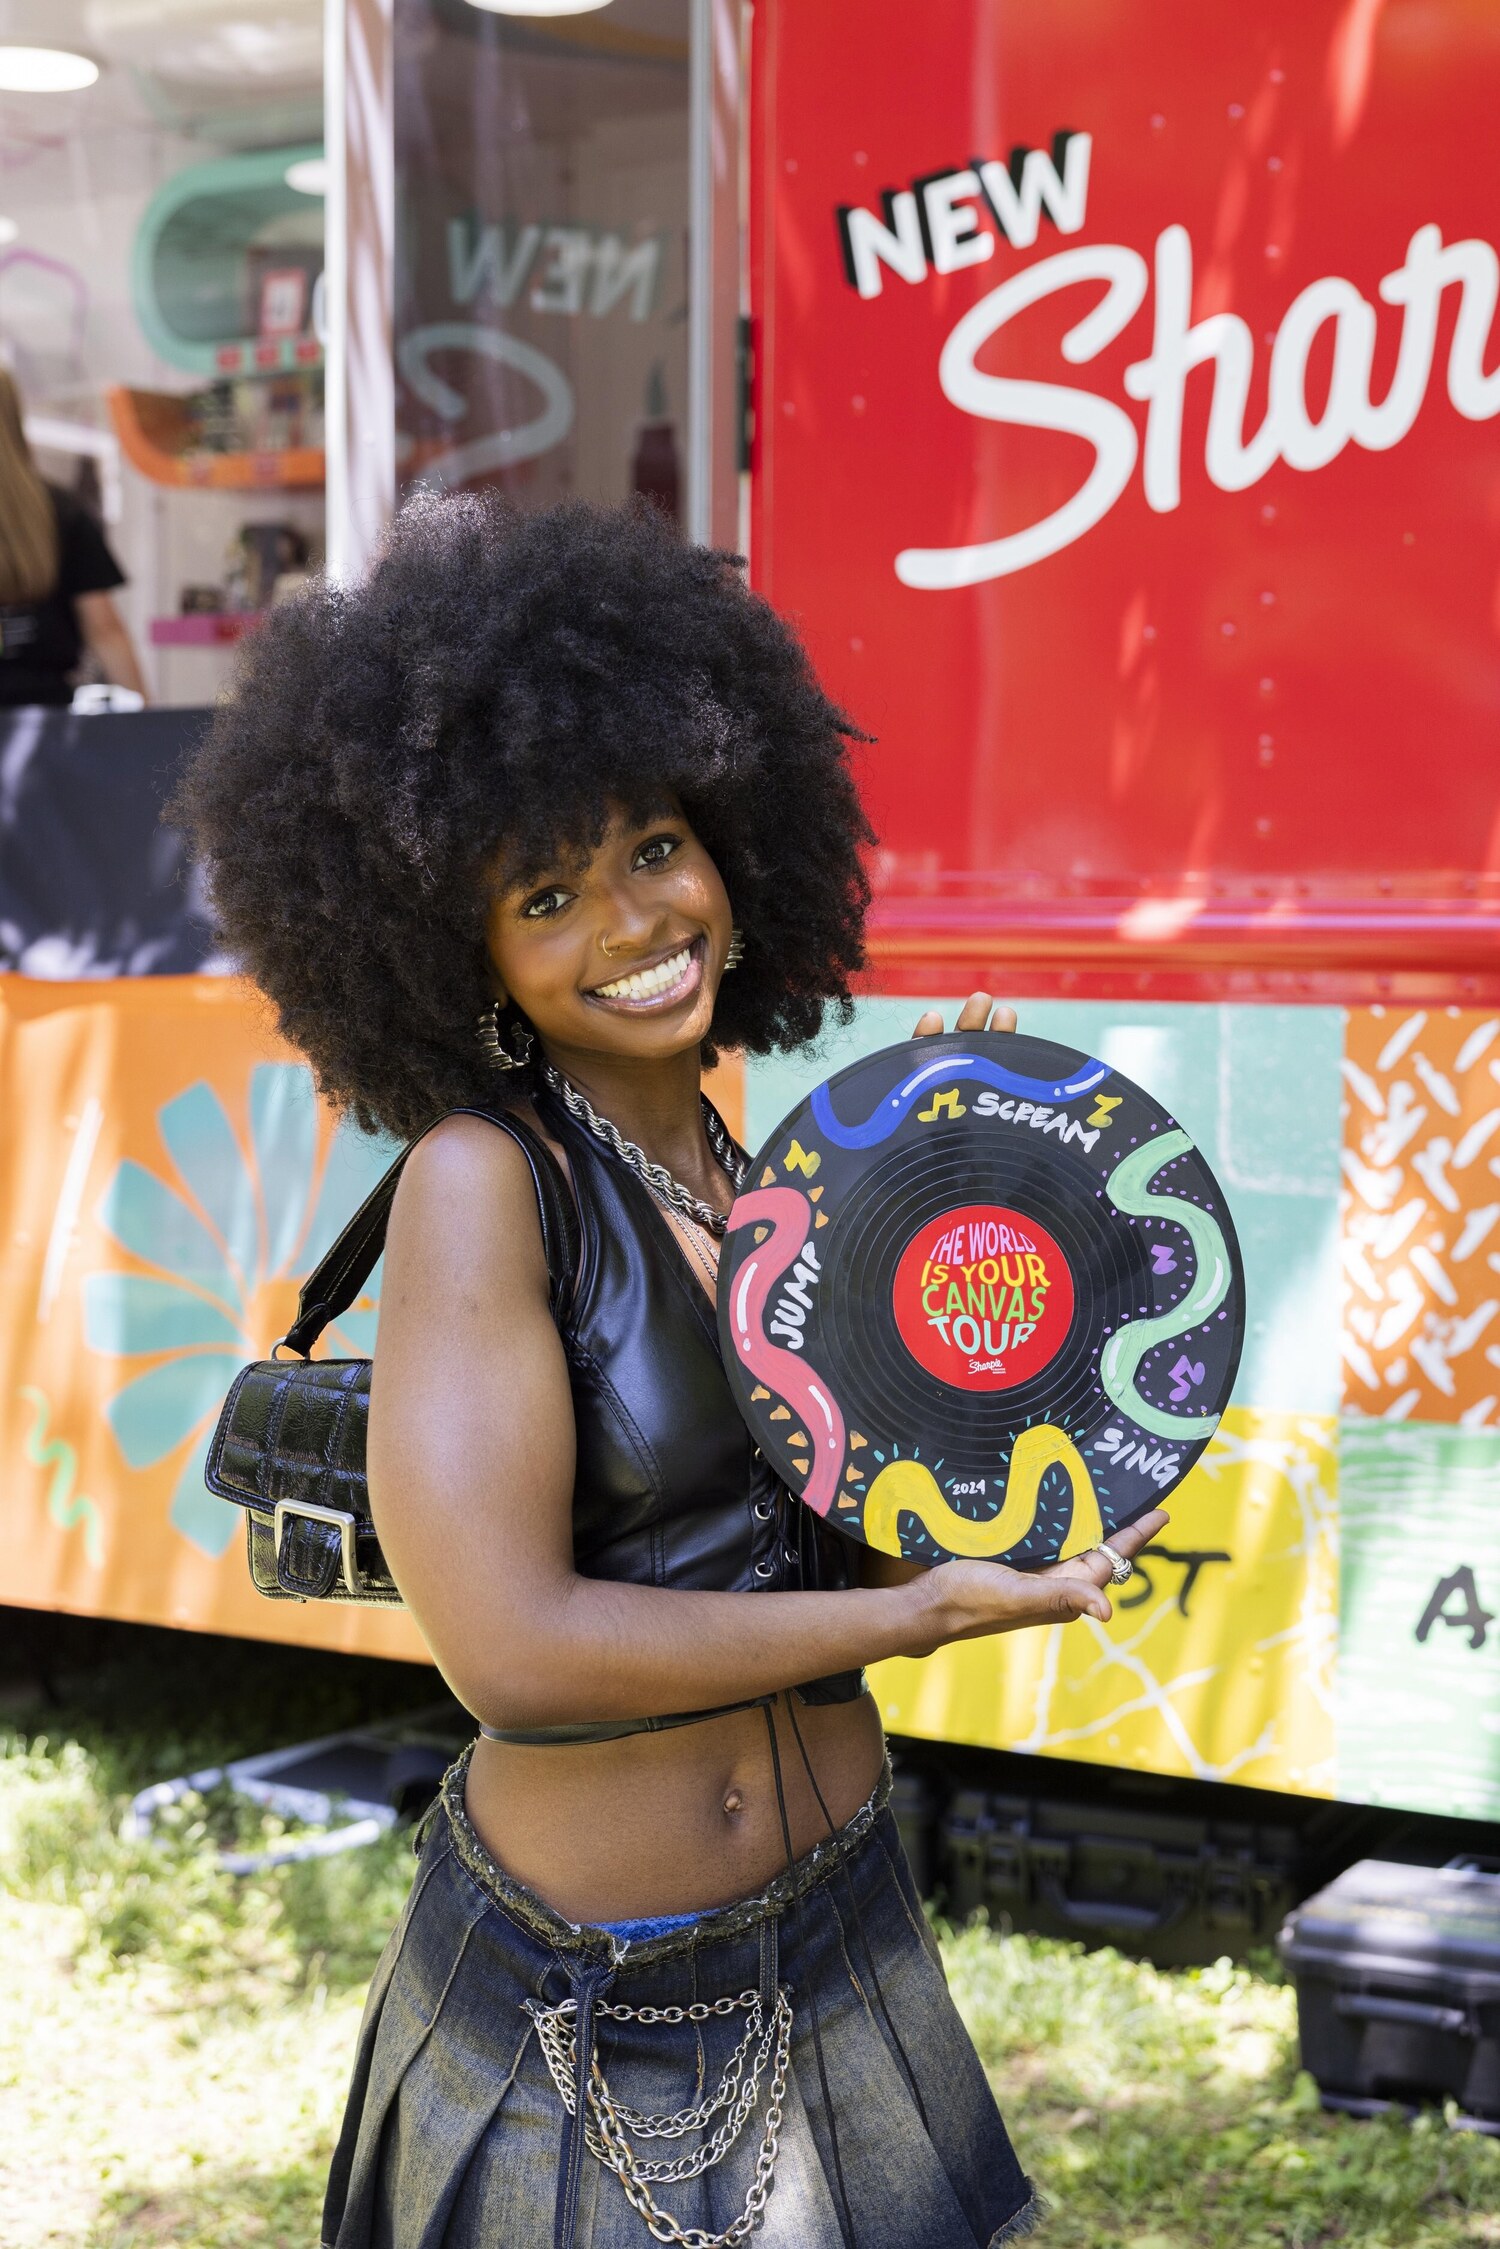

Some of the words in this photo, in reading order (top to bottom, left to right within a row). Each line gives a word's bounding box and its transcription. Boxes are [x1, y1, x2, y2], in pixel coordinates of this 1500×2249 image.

[838, 130, 1093, 300] NEW
[971, 1091, 1101, 1154] SCREAM
[929, 1225, 966, 1265] THE
[968, 1221, 1037, 1262] WORLD
[920, 1260, 950, 1288] IS
[960, 1253, 1052, 1288] YOUR
[769, 1241, 822, 1350] JUMP
[921, 1281, 1047, 1323] CANVAS
[927, 1314, 1037, 1356] TOUR
[1093, 1427, 1181, 1489] SING
[952, 1479, 986, 1495] 2024
